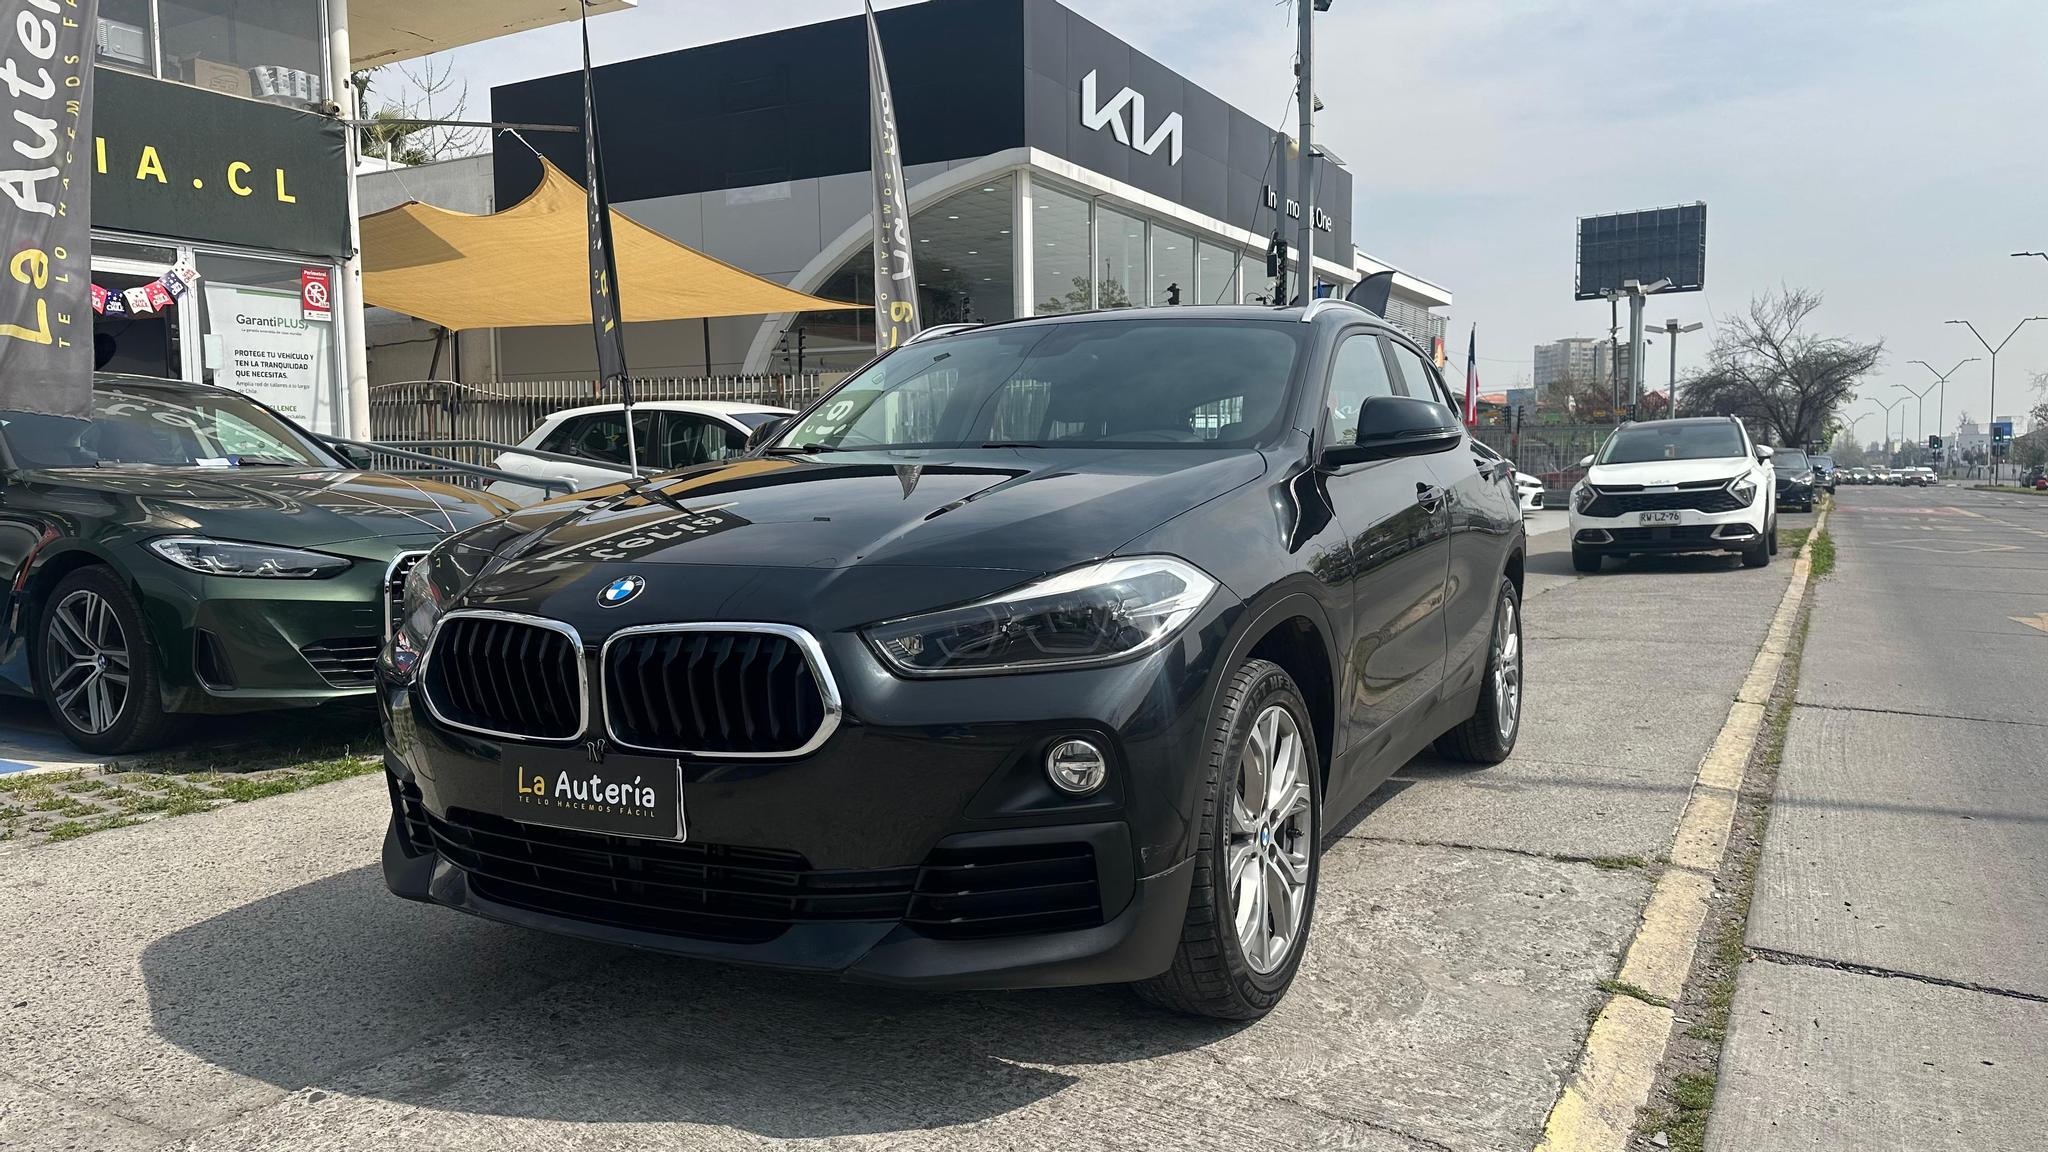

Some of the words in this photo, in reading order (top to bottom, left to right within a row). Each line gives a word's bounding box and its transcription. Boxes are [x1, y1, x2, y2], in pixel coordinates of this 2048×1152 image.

[1081, 68, 1183, 166] KIA
[58, 54, 81, 217] HACEMOS
[1315, 207, 1332, 232] One
[54, 246, 70, 283] LO
[0, 248, 53, 345] La
[58, 312, 72, 348] TE
[234, 350, 266, 358] PROTEGE
[277, 351, 309, 360] VEHÍCULO
[260, 361, 308, 370] TRANQUILIDAD
[235, 370, 250, 378] QUE
[518, 766, 546, 796] La
[554, 770, 655, 808] Autería
[519, 796, 530, 804] TE
[537, 798, 549, 806] LO
[557, 800, 611, 813] HACEMOS
[619, 806, 655, 818] FÁCIL
